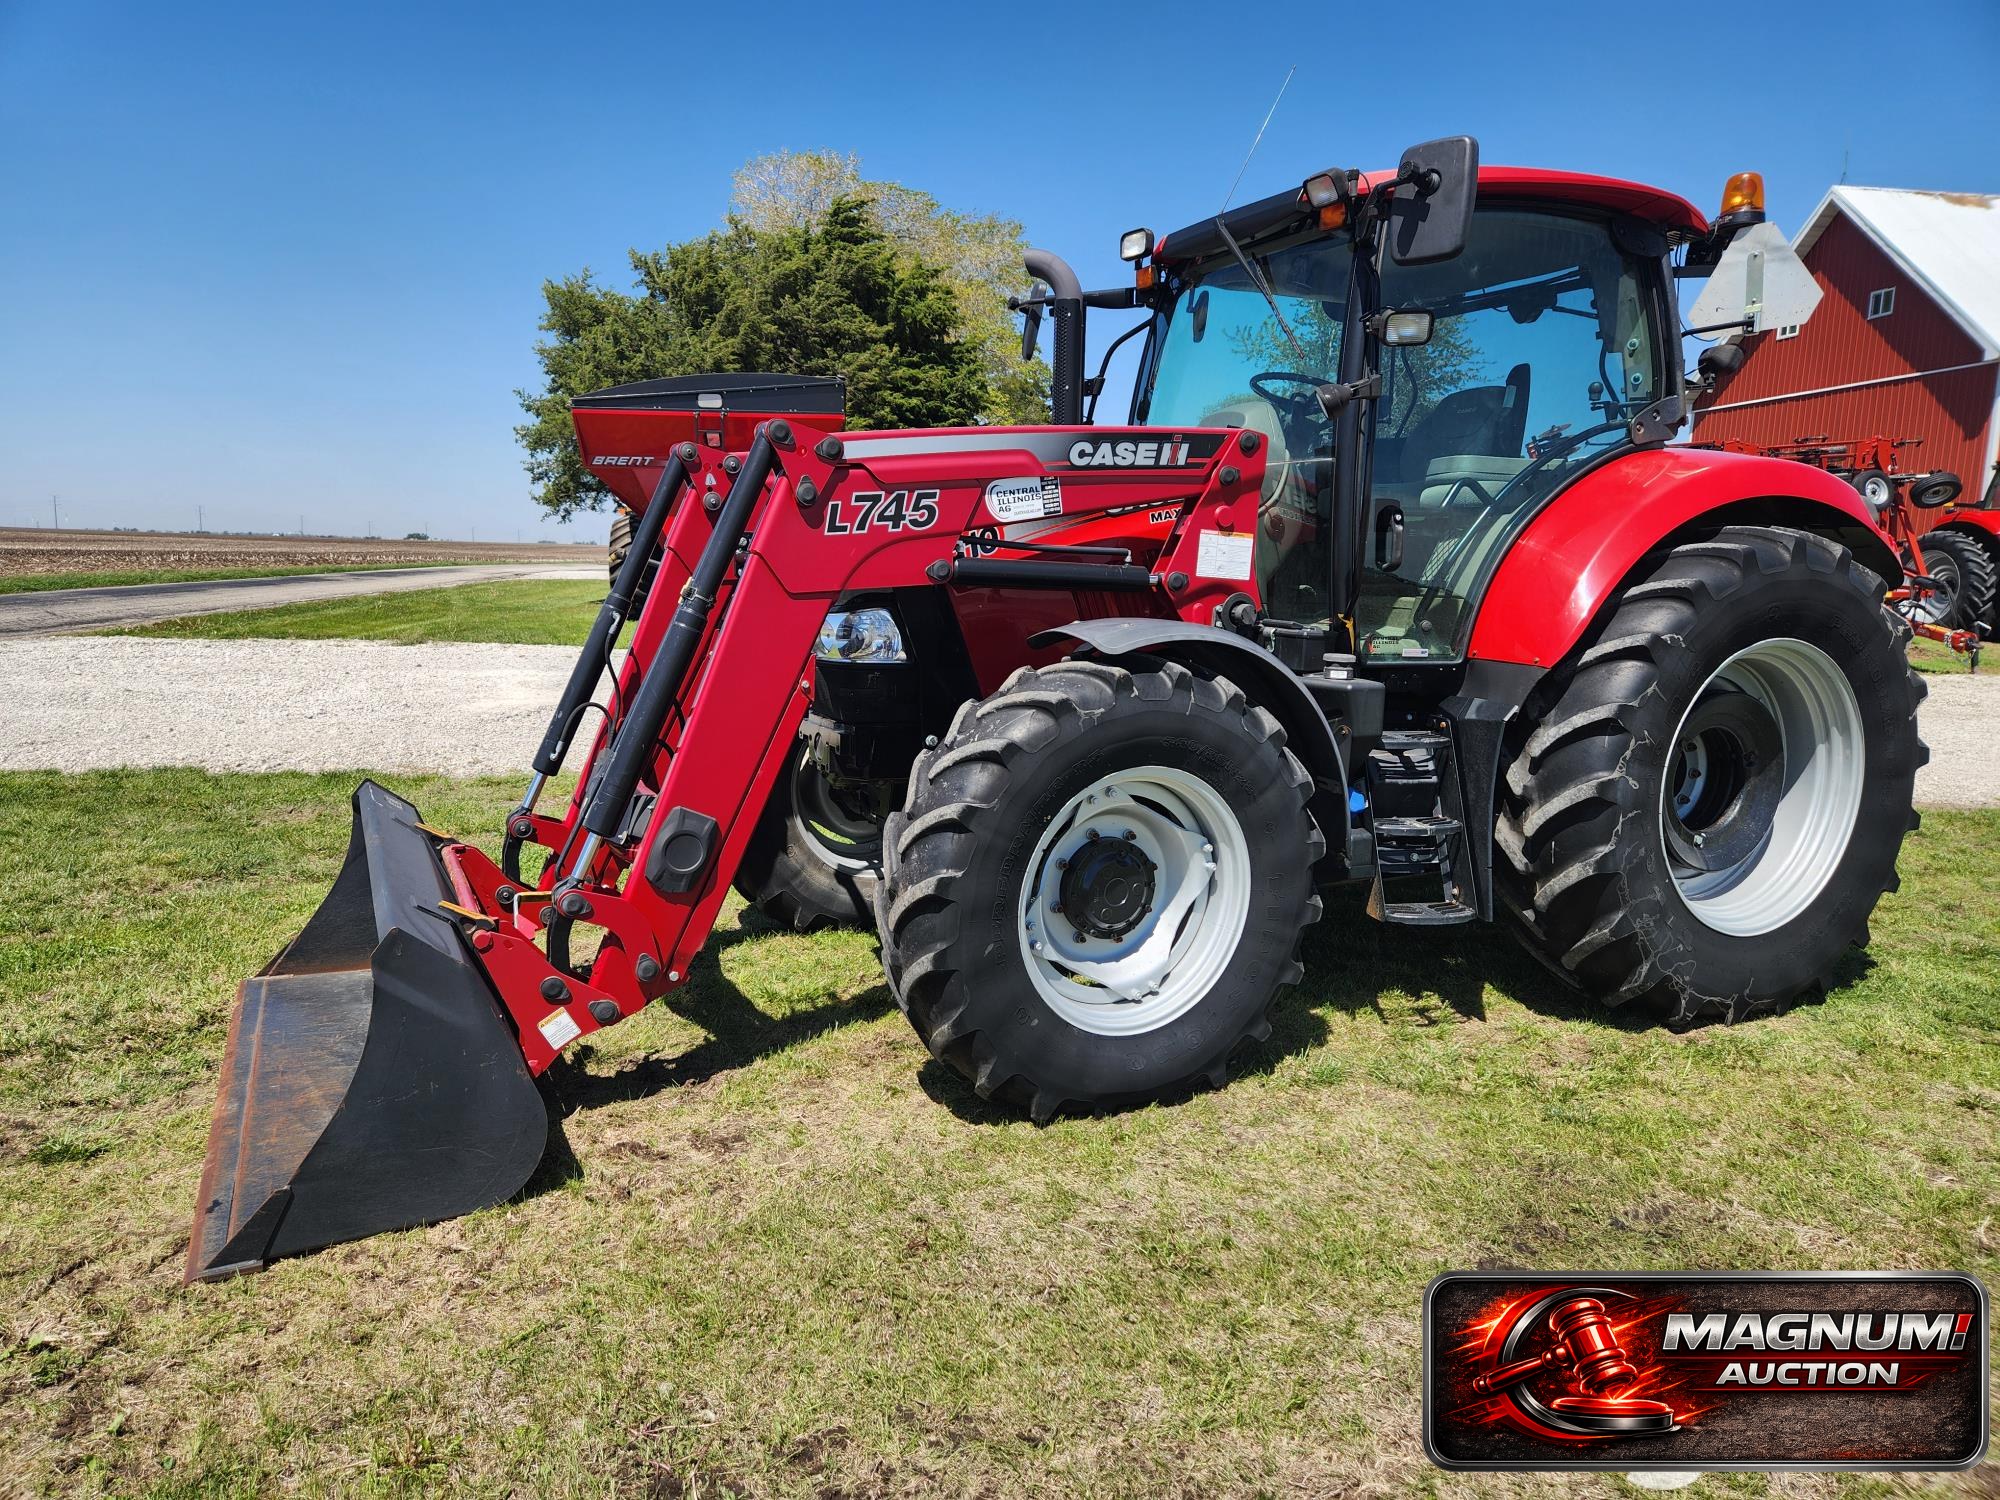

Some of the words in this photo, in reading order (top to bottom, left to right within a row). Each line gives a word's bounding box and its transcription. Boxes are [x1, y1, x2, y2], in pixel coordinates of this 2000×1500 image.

[1069, 441, 1159, 466] CASE
[592, 455, 655, 466] BRENT
[996, 486, 1041, 499] CENTRAL
[997, 493, 1042, 506] ILLINOIS
[824, 489, 940, 536] L745
[998, 505, 1012, 514] AG
